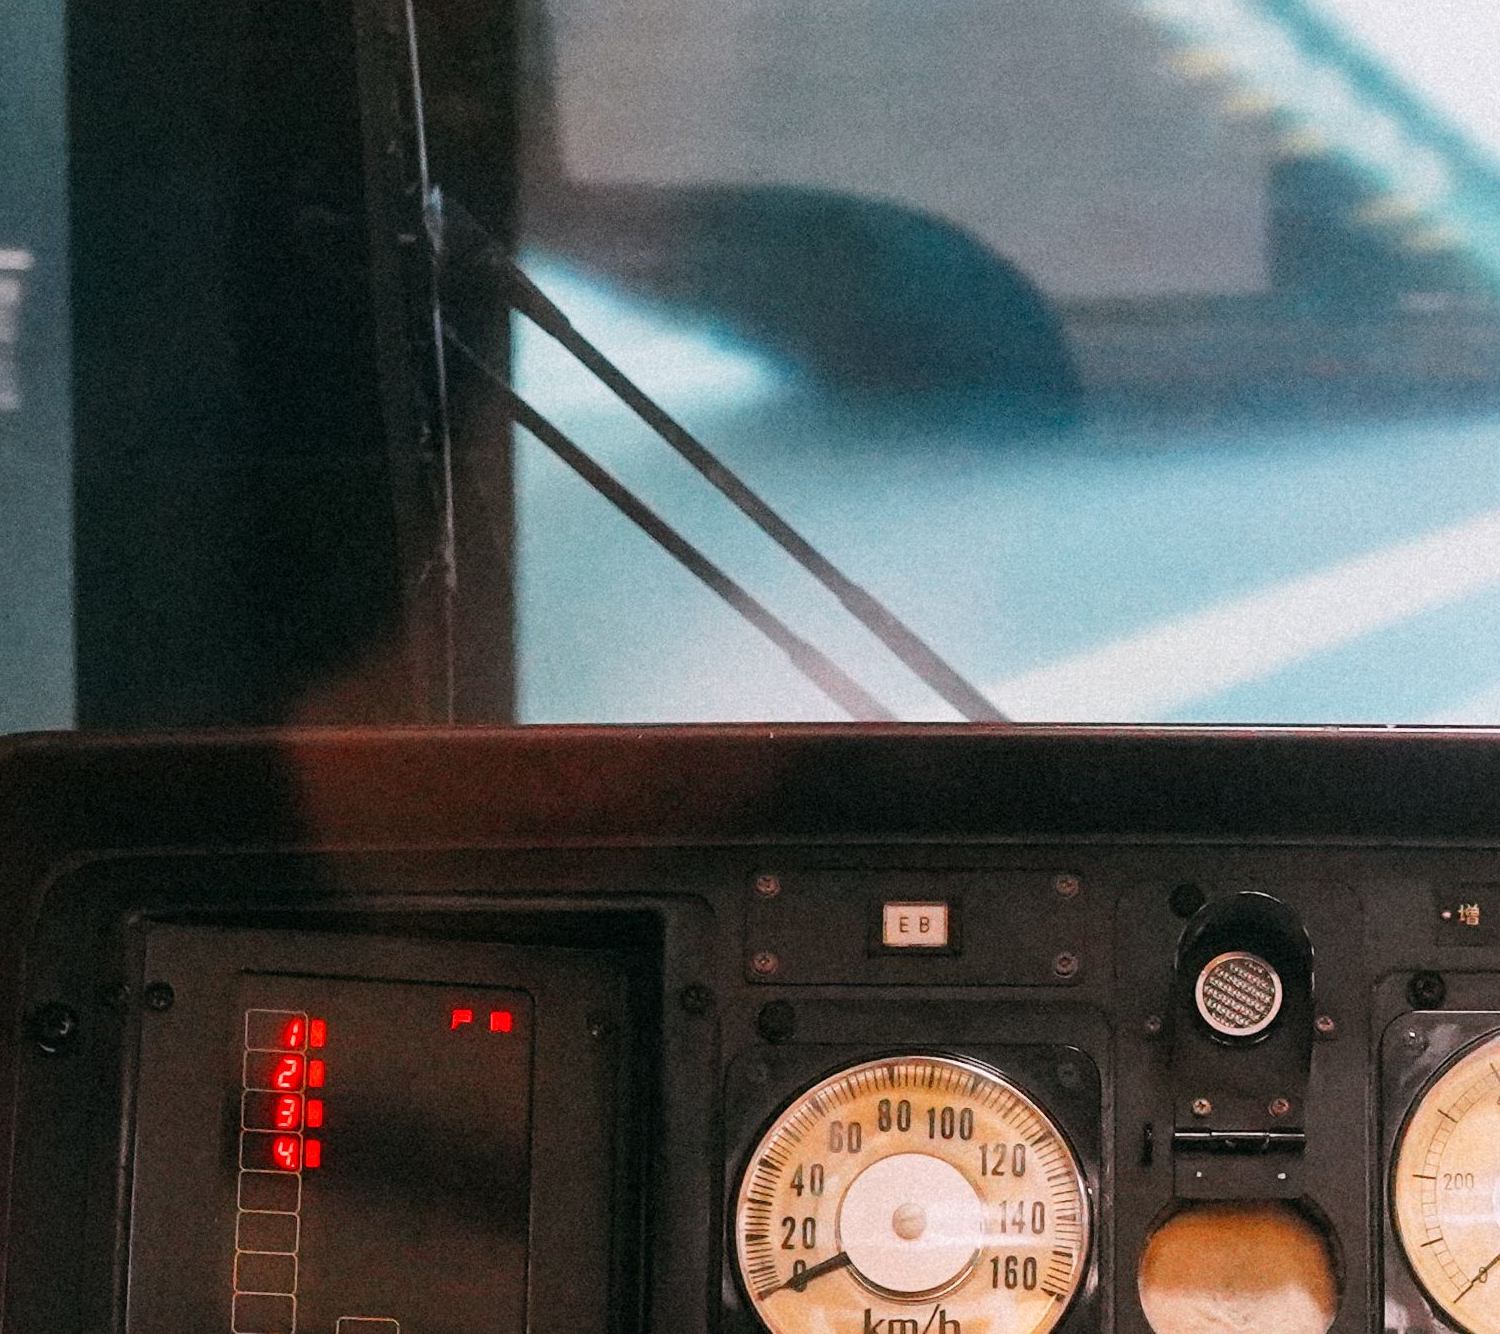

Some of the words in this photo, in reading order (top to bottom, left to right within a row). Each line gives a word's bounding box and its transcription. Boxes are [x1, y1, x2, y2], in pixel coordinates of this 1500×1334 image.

[898, 915, 931, 934] EB
[289, 1021, 300, 1047] 1
[277, 1058, 298, 1088] 2
[278, 1098, 295, 1128] 3
[876, 1098, 912, 1133] 80
[927, 1106, 975, 1140] 100
[827, 1119, 863, 1154] 60
[978, 1142, 1027, 1177] 120
[790, 1163, 825, 1197] 40
[1443, 1172, 1475, 1191] 200
[781, 1216, 817, 1250] 20
[999, 1200, 1046, 1235] 140
[990, 1255, 1038, 1291] 160
